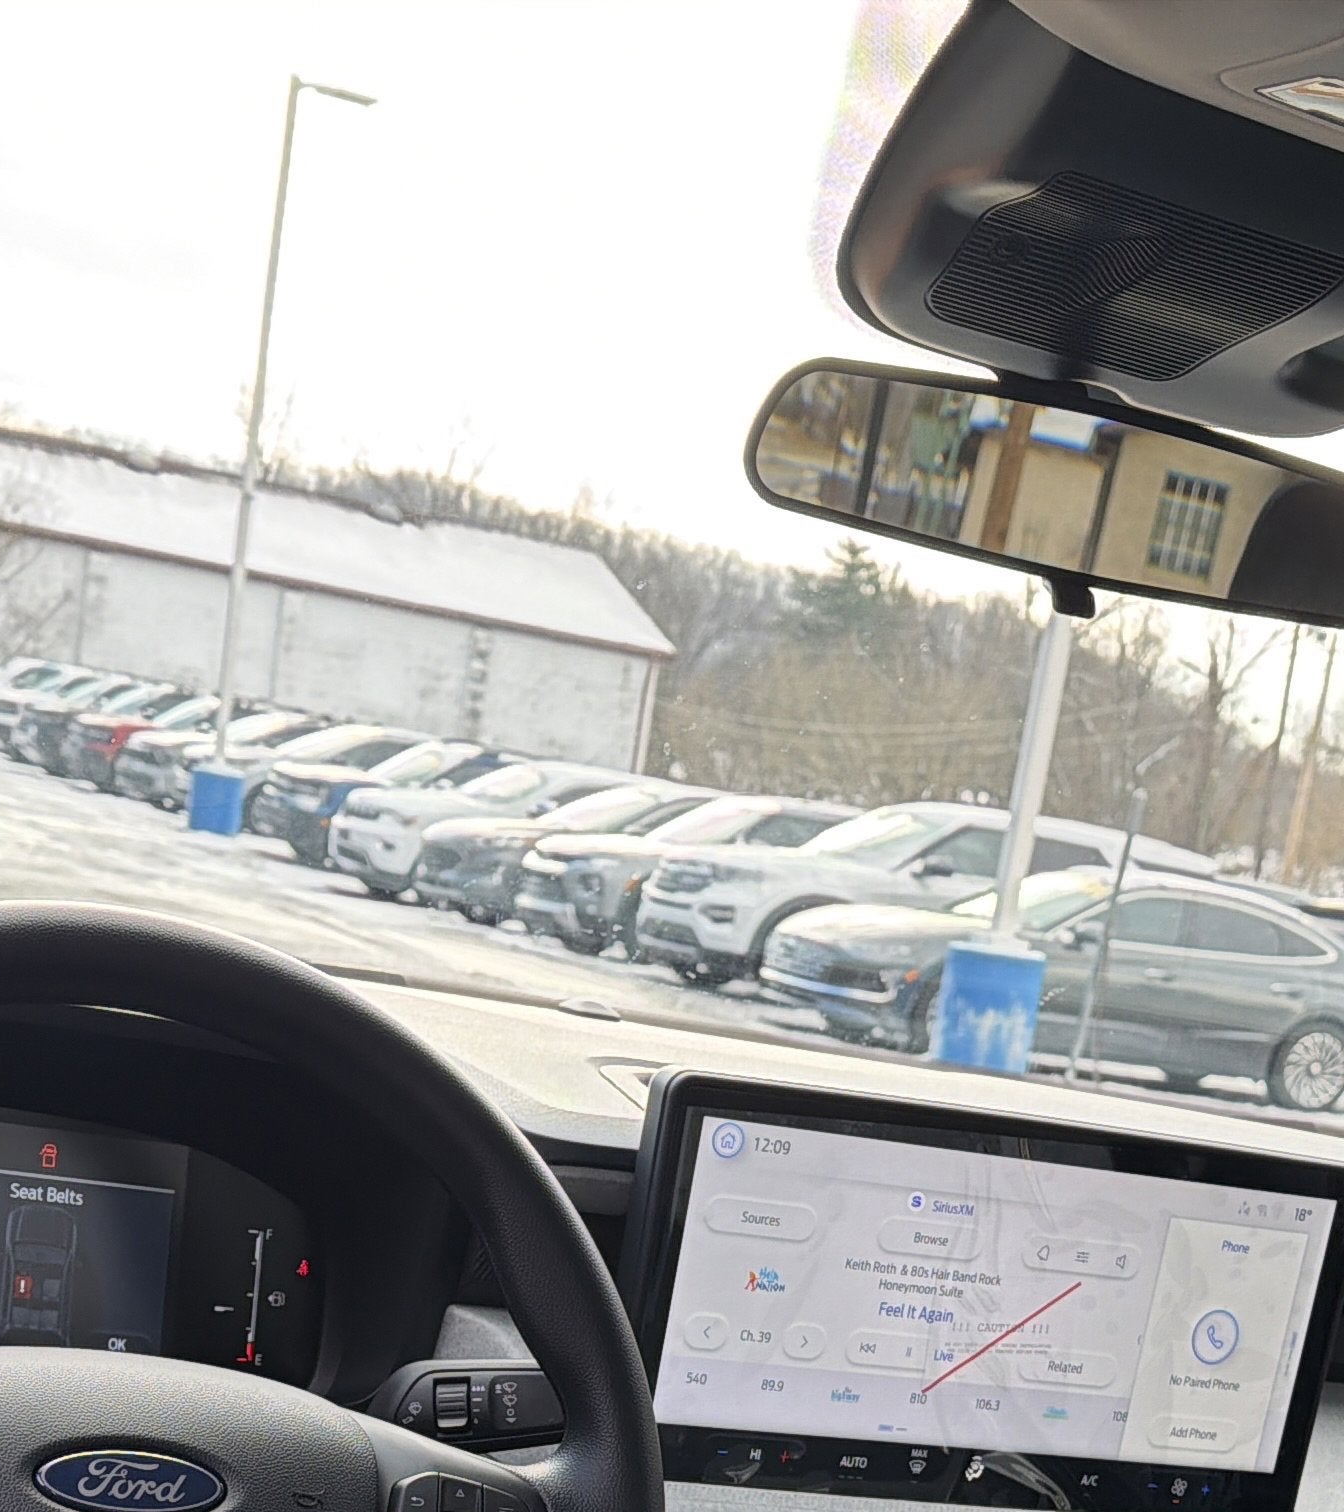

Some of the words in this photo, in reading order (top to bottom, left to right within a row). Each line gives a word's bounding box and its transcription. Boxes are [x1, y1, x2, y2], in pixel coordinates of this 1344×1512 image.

[753, 1136, 791, 1156] 12:09
[9, 1182, 44, 1202] Seat
[46, 1187, 84, 1206] Belts
[932, 1200, 975, 1217] SiriusXM
[741, 1210, 781, 1227] Sources
[265, 1228, 273, 1241] F
[913, 1231, 949, 1247] Browse
[1221, 1239, 1250, 1255] Phone
[845, 1257, 871, 1272] Keith
[873, 1261, 897, 1275] Roth
[900, 1264, 909, 1276] &
[910, 1265, 930, 1279] 80s
[930, 1268, 951, 1281] Hair
[952, 1270, 977, 1283] Band
[978, 1273, 1002, 1286] Rock
[878, 1278, 938, 1296] Honeymoon
[938, 1285, 964, 1298] Suite
[878, 1301, 905, 1318] Feel
[906, 1303, 916, 1320] It
[918, 1306, 954, 1324] Again
[740, 1329, 756, 1342] Ch.
[756, 1330, 772, 1343] 39
[108, 1337, 127, 1351] OK
[254, 1353, 262, 1366] E
[933, 1349, 954, 1363] Live
[1047, 1359, 1083, 1375] Related
[685, 1371, 708, 1386] 540
[760, 1378, 785, 1393] 89.9
[1169, 1374, 1182, 1386] No
[1183, 1377, 1211, 1390] Paired
[1212, 1379, 1240, 1393] Phone
[909, 1392, 928, 1405] 810
[975, 1398, 1001, 1412] 106.3
[1170, 1425, 1189, 1438] Add
[1190, 1428, 1218, 1442] Phone
[749, 1448, 761, 1462] HI
[911, 1449, 929, 1458] MAX
[840, 1455, 868, 1470] AUTO
[77, 1457, 187, 1504] Ford
[1080, 1473, 1099, 1487] A/C
